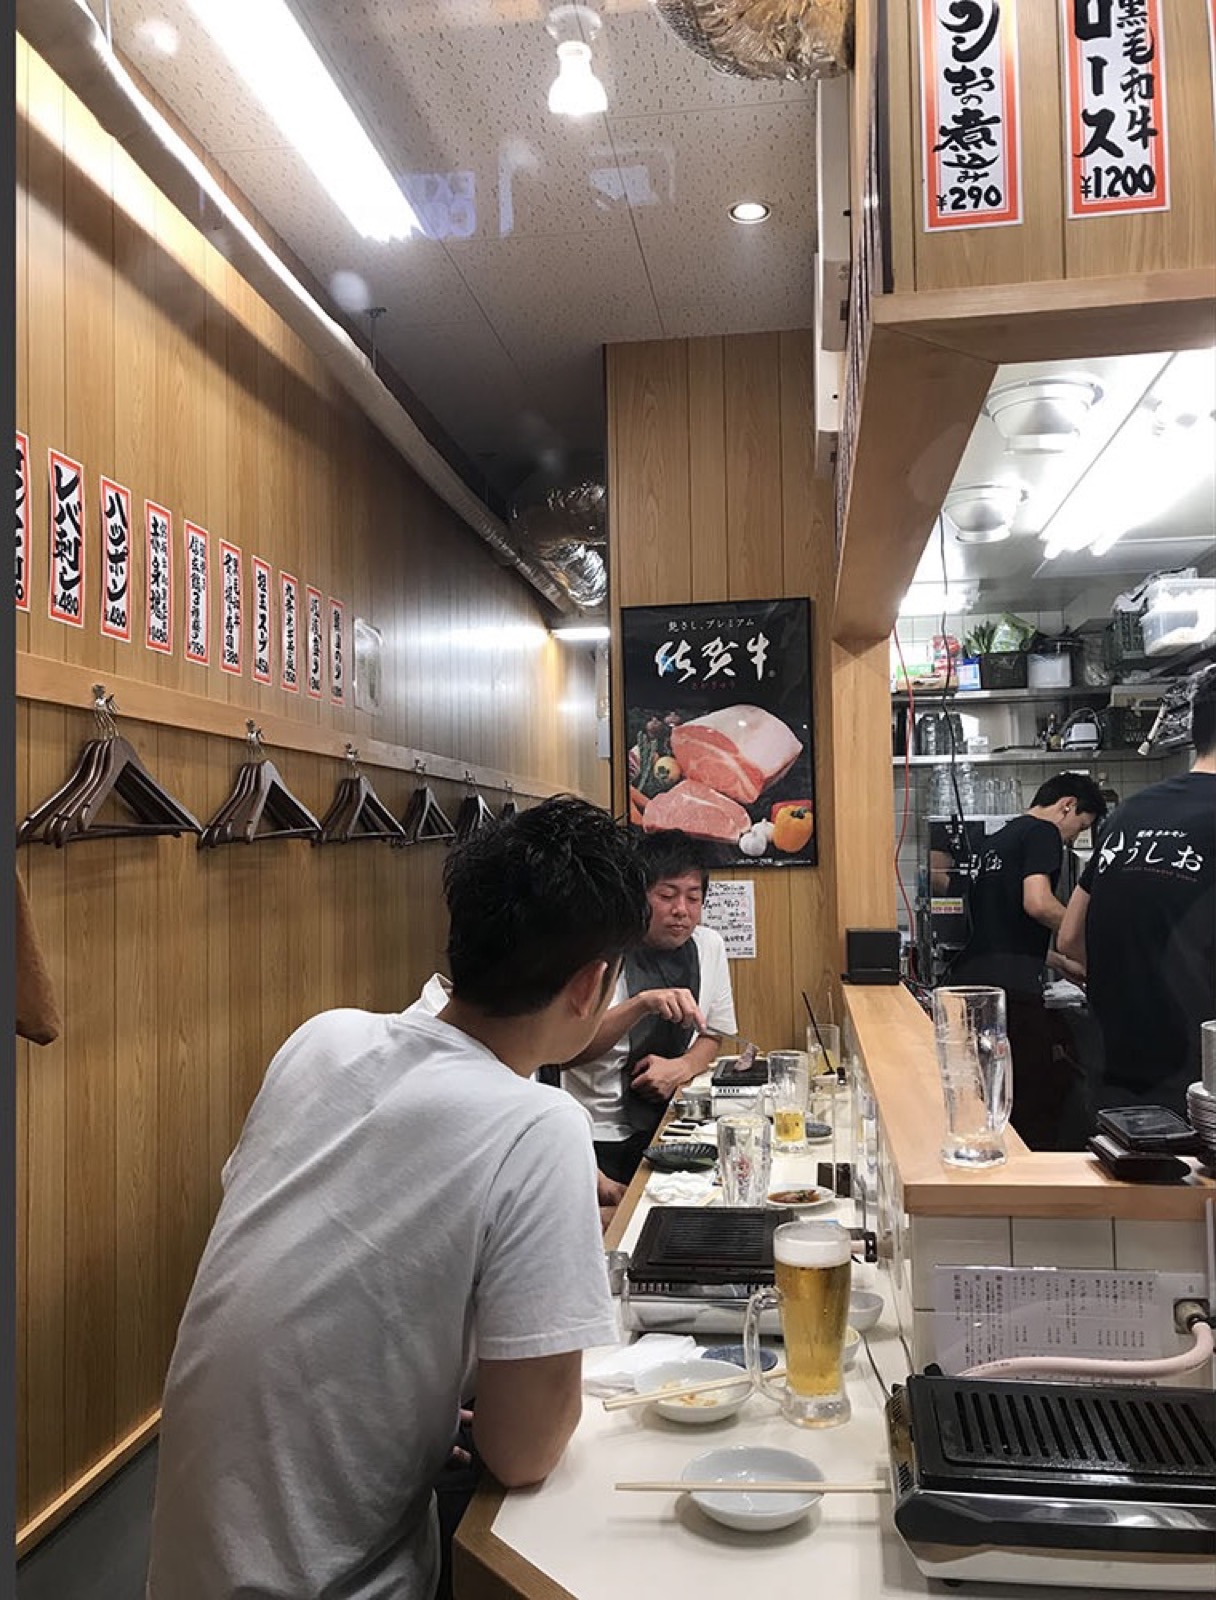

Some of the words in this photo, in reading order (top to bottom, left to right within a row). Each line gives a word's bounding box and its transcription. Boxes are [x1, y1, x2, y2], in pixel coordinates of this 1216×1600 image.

[1073, 0, 1124, 158] ロース
[936, 185, 1003, 211] ¥290
[655, 632, 770, 683] 佐賀牛
[1125, 841, 1204, 872] うしお
